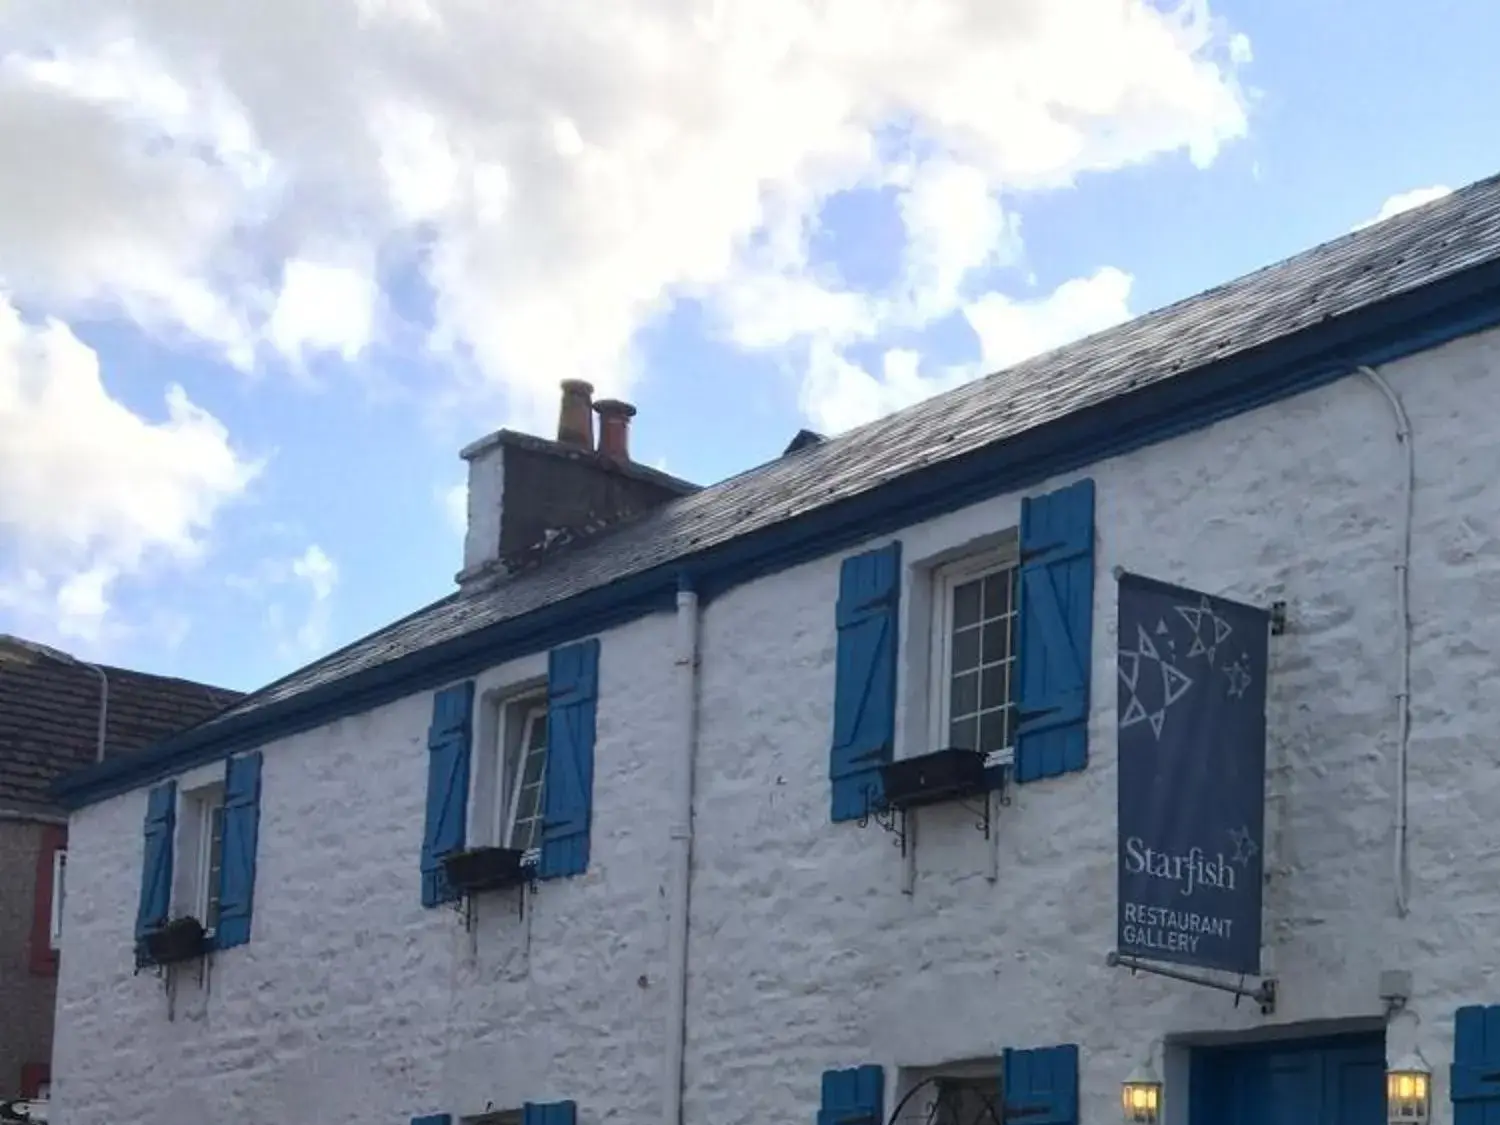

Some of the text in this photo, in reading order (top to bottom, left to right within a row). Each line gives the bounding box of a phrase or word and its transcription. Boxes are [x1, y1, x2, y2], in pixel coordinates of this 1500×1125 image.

[1125, 836, 1235, 895] Starfish
[1125, 903, 1233, 938] RESTAURANT
[1123, 925, 1200, 953] GALLERY
